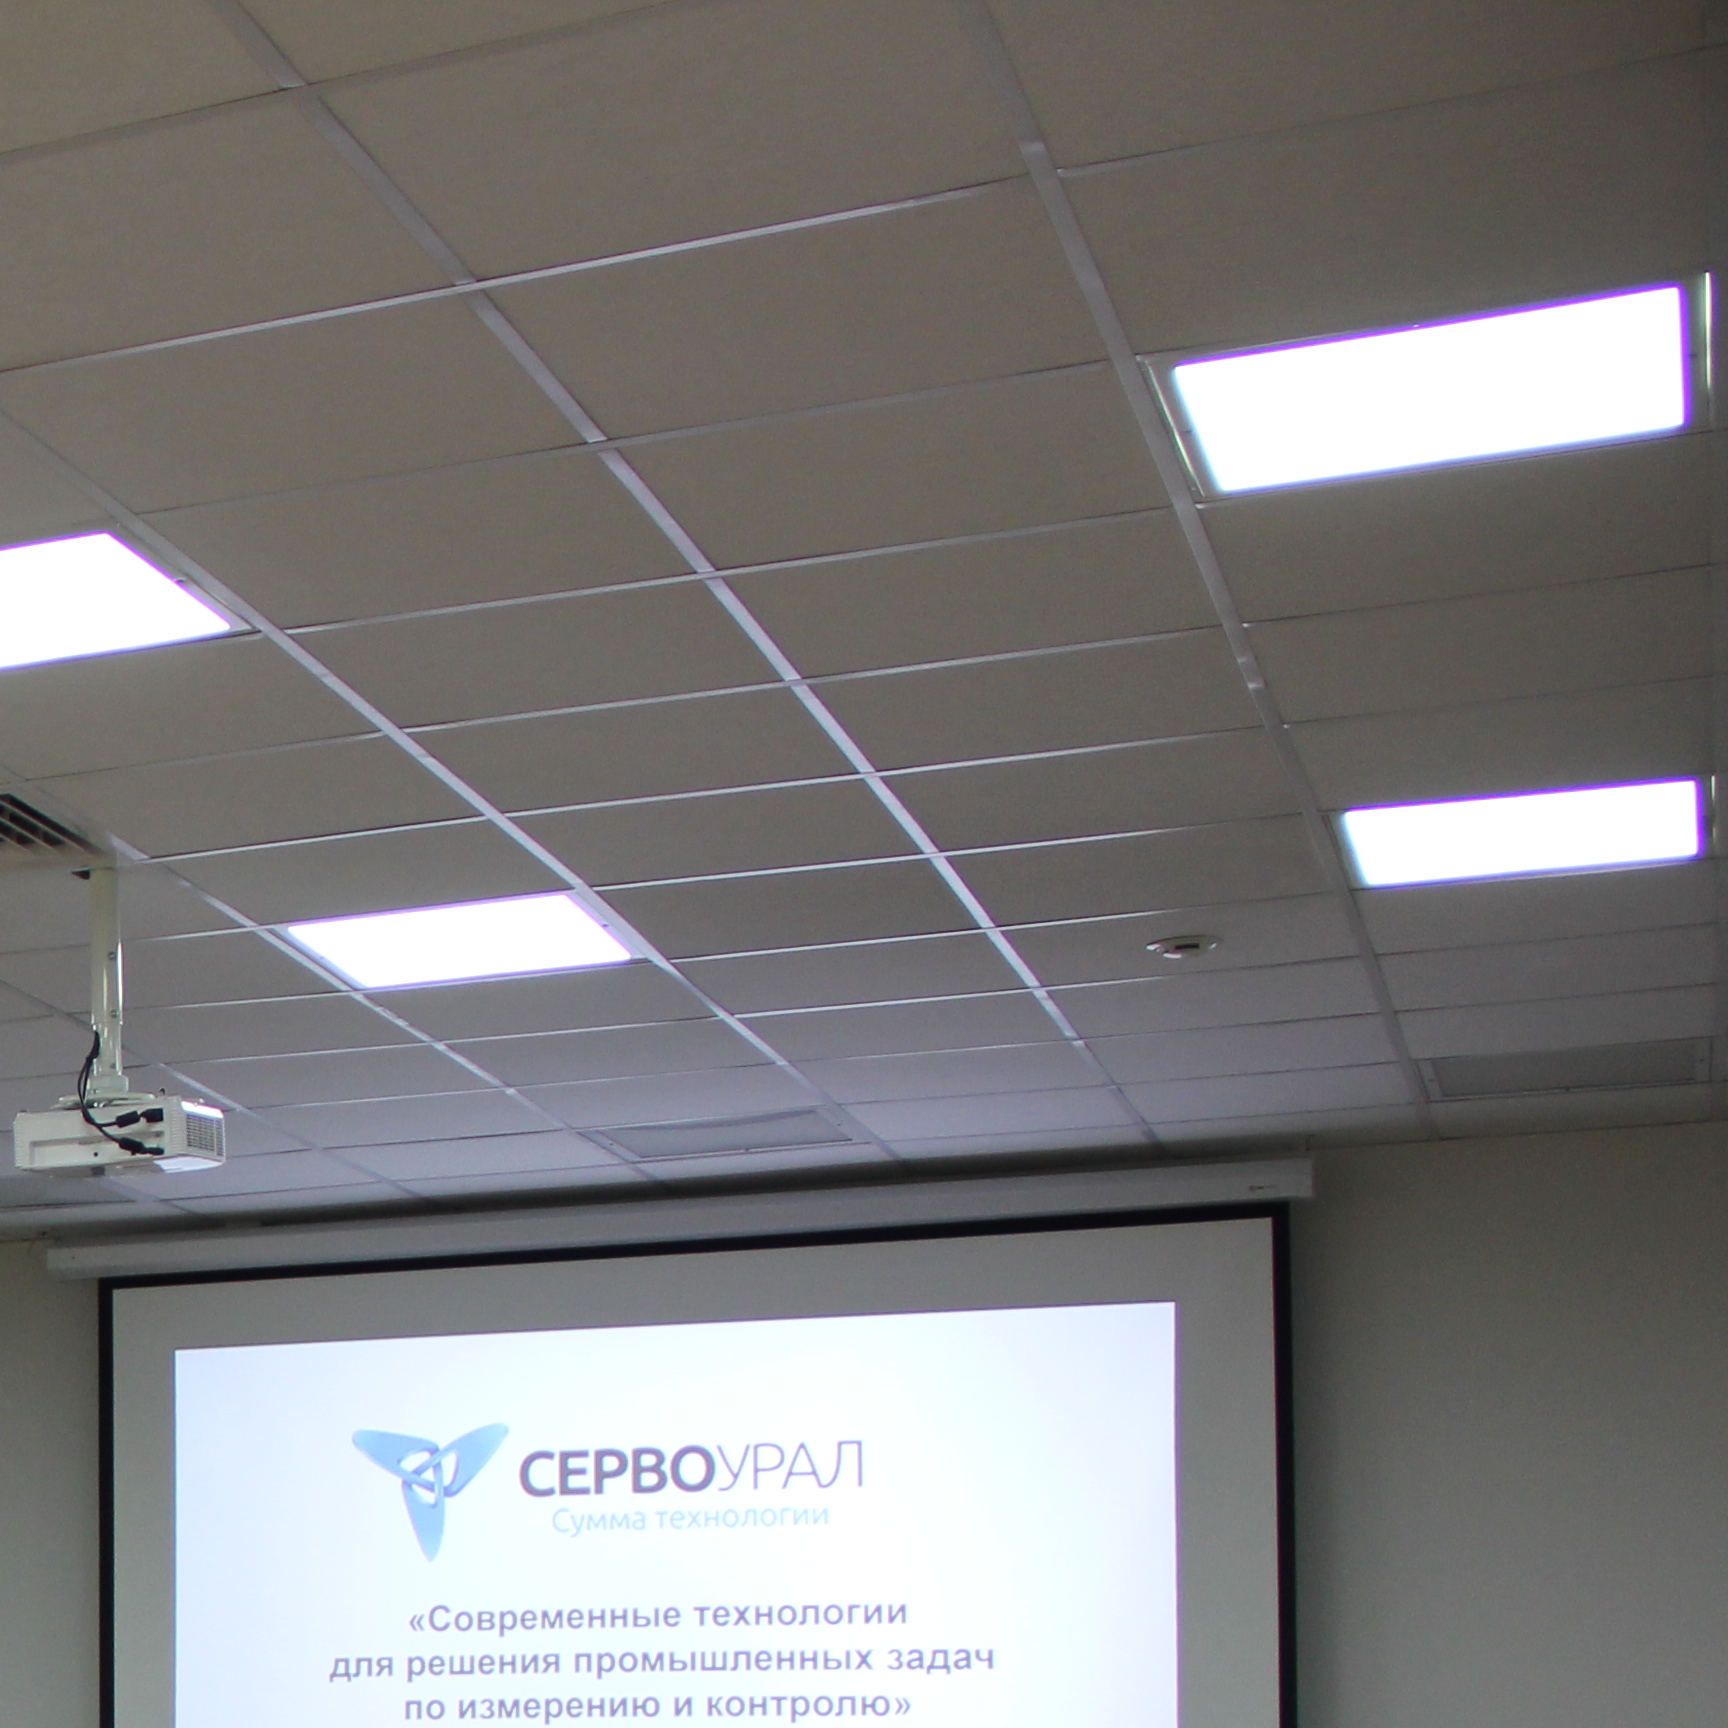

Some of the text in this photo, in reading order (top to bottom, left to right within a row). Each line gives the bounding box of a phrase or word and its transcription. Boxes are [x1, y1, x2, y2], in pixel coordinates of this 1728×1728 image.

[519, 1441, 863, 1497] СЕРВОУРАЛ
[552, 1507, 830, 1538] Сумма технологии
[410, 1603, 907, 1637] «Современные технологии
[329, 1648, 995, 1683] для решения промышленных задач
[405, 1694, 912, 1725] по измерению и контролю»
